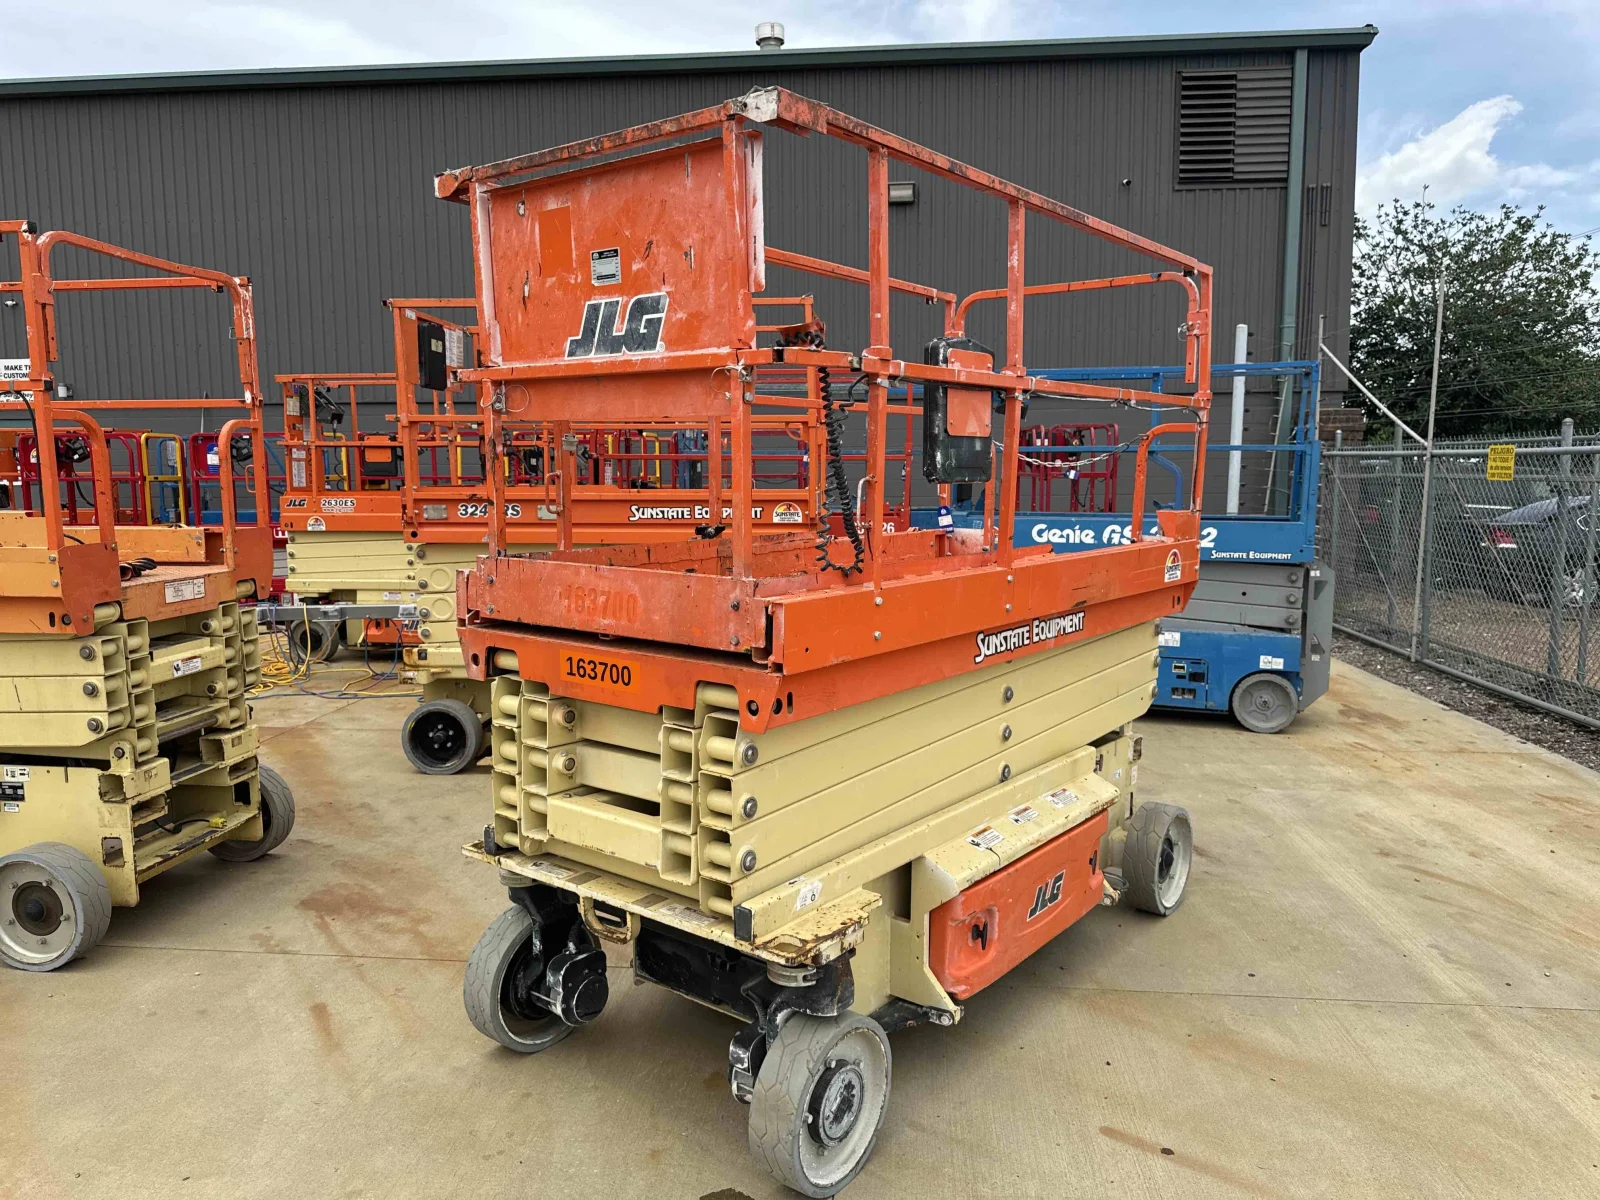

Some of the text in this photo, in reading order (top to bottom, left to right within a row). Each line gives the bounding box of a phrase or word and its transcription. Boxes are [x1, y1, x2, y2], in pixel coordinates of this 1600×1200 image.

[565, 292, 669, 360] JLG
[286, 499, 307, 507] JLG
[322, 499, 356, 507] 2630ES
[1032, 524, 1095, 544] Genie
[975, 611, 1085, 664] SUNSTATE EQUIPMENT
[566, 657, 632, 686] 163700
[1027, 869, 1066, 922] JLG
